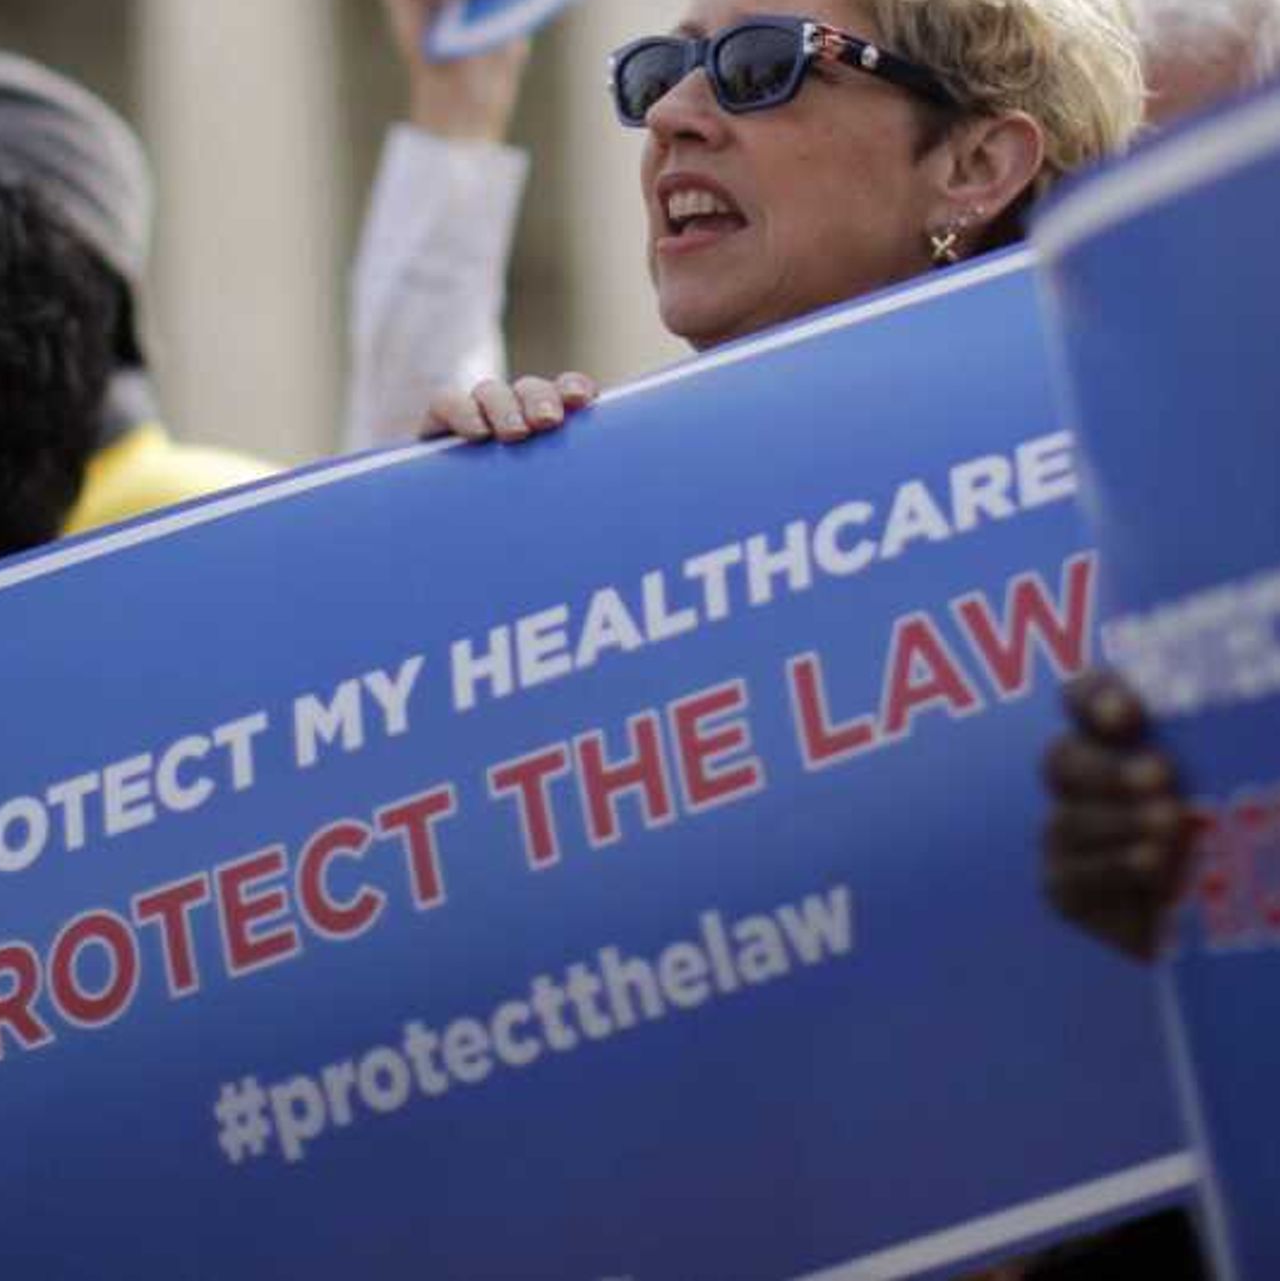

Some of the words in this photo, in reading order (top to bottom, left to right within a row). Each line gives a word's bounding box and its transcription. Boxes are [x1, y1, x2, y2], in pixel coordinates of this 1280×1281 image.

[292, 653, 426, 768] MY
[487, 678, 766, 871] THE
[785, 549, 1100, 771] LAW
[213, 884, 854, 1165] #protectthelaw
